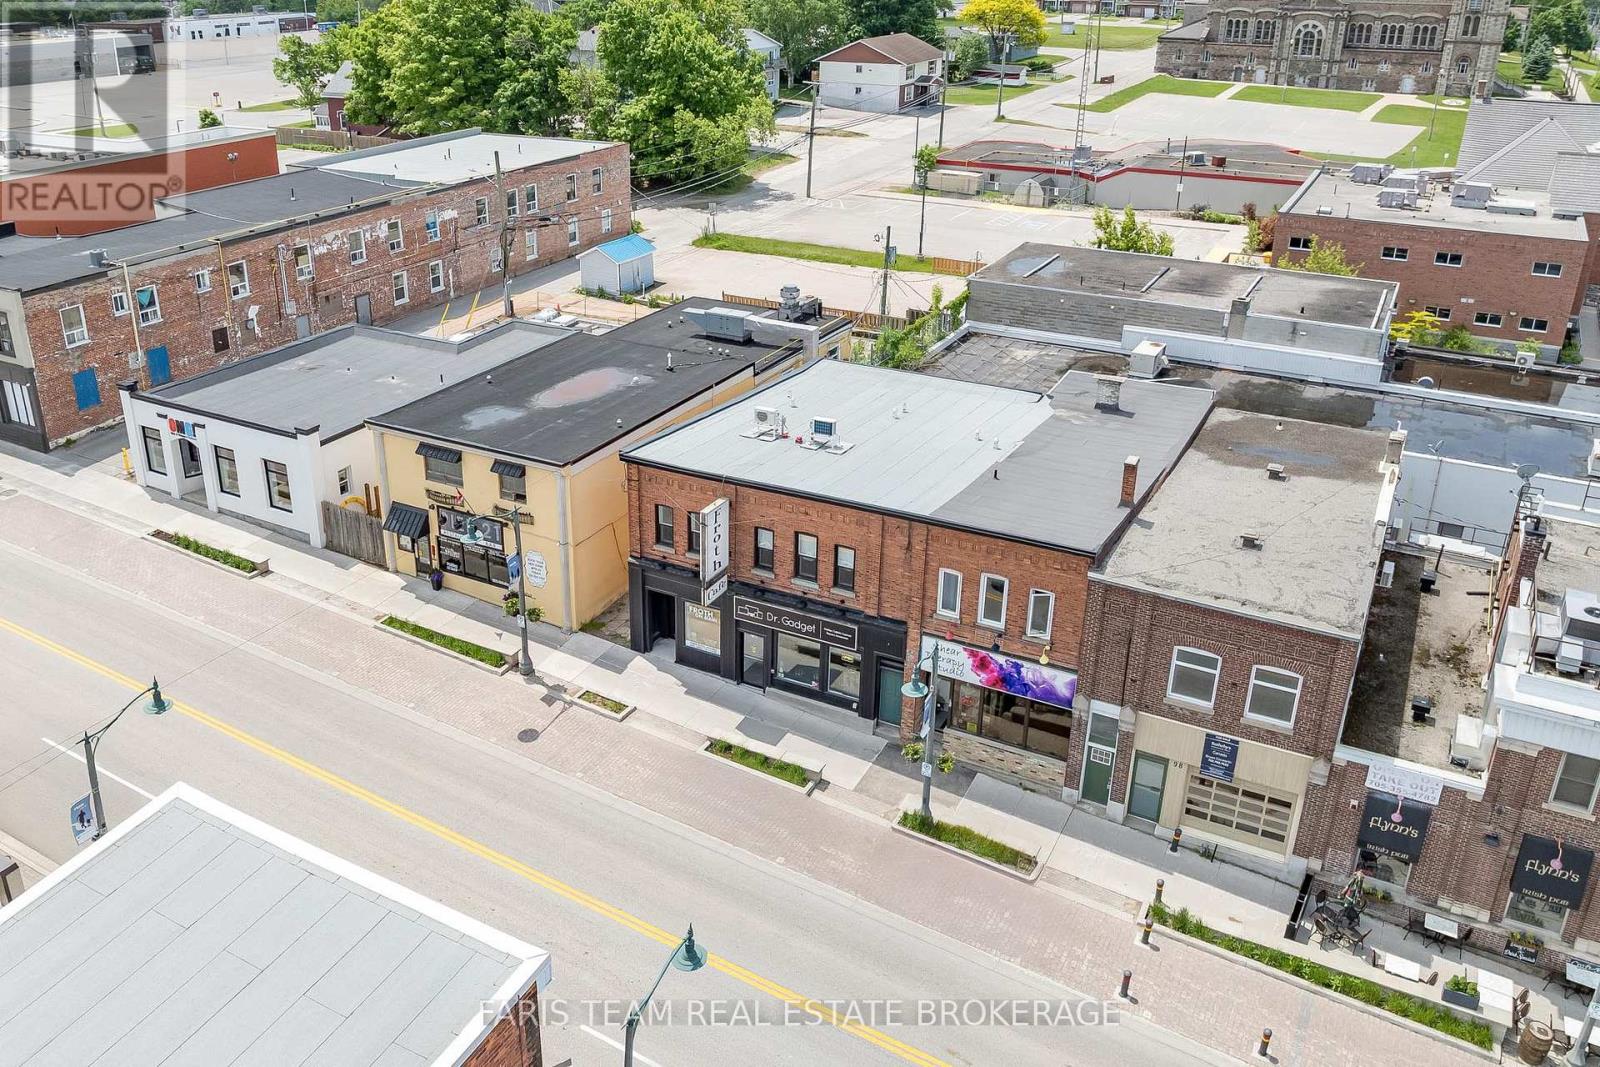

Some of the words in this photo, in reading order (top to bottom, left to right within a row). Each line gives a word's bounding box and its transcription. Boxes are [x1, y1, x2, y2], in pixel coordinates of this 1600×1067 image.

[713, 506, 722, 572] Froth
[766, 611, 781, 624] Dr.
[781, 616, 816, 633] Gadget
[938, 663, 965, 678] tudio
[1173, 760, 1183, 769] 98
[1370, 771, 1405, 787] TAKE
[1409, 782, 1438, 796] OUT
